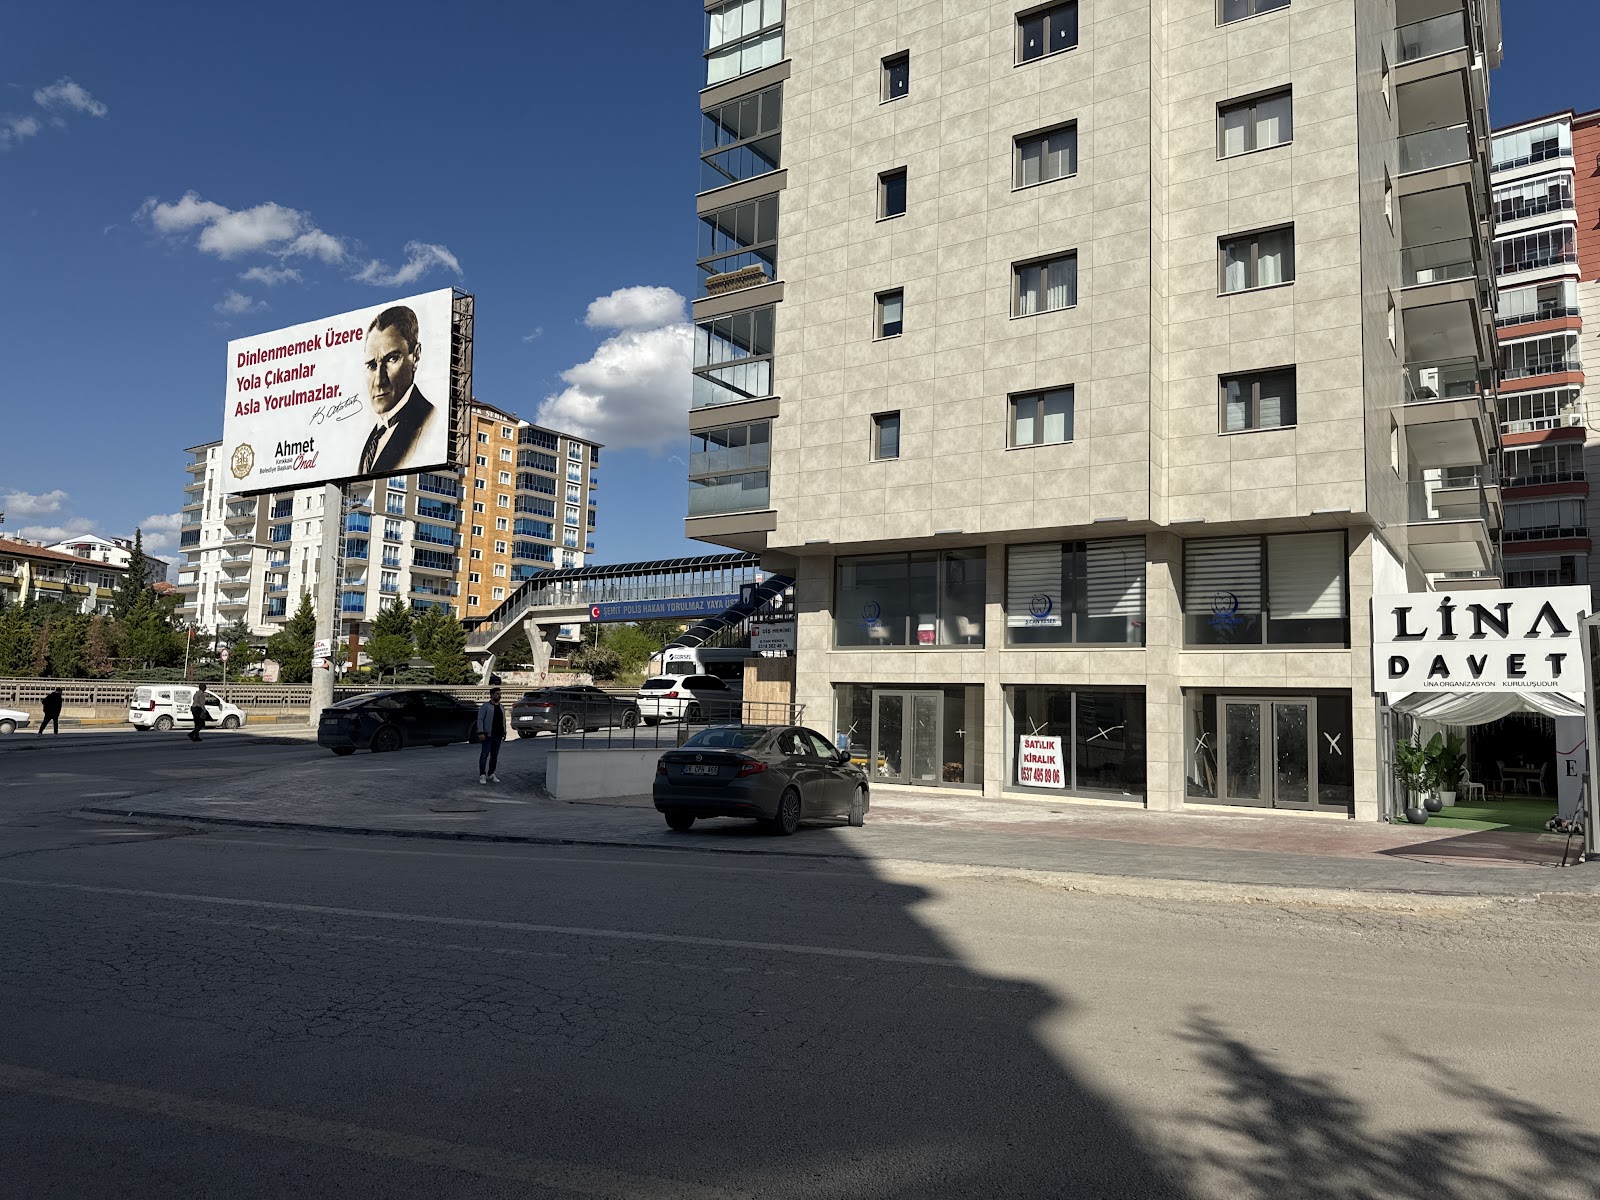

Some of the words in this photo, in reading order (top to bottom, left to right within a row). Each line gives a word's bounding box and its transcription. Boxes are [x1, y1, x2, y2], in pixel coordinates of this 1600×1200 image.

[237, 334, 321, 368] Dinlenmemek
[325, 327, 363, 348] Üzere
[236, 375, 261, 392] Yola
[264, 362, 316, 387] Çıkanlar
[235, 398, 260, 417] Asla
[264, 383, 342, 411] Yorulmazlar.
[274, 437, 315, 458] Ahmet
[293, 451, 319, 470] Önal
[603, 605, 621, 617] ŞEHİT
[642, 603, 665, 613] HAKAN
[666, 601, 704, 611] YORULMAZ
[706, 599, 723, 609] YAYA
[1391, 595, 1572, 641] LİNA
[1388, 652, 1567, 679] DAVET
[1502, 680, 1559, 688] KURULUŞUDUR
[1024, 739, 1055, 750] SATILIK
[1023, 752, 1056, 765] KİRALIK
[1044, 768, 1052, 784] 89
